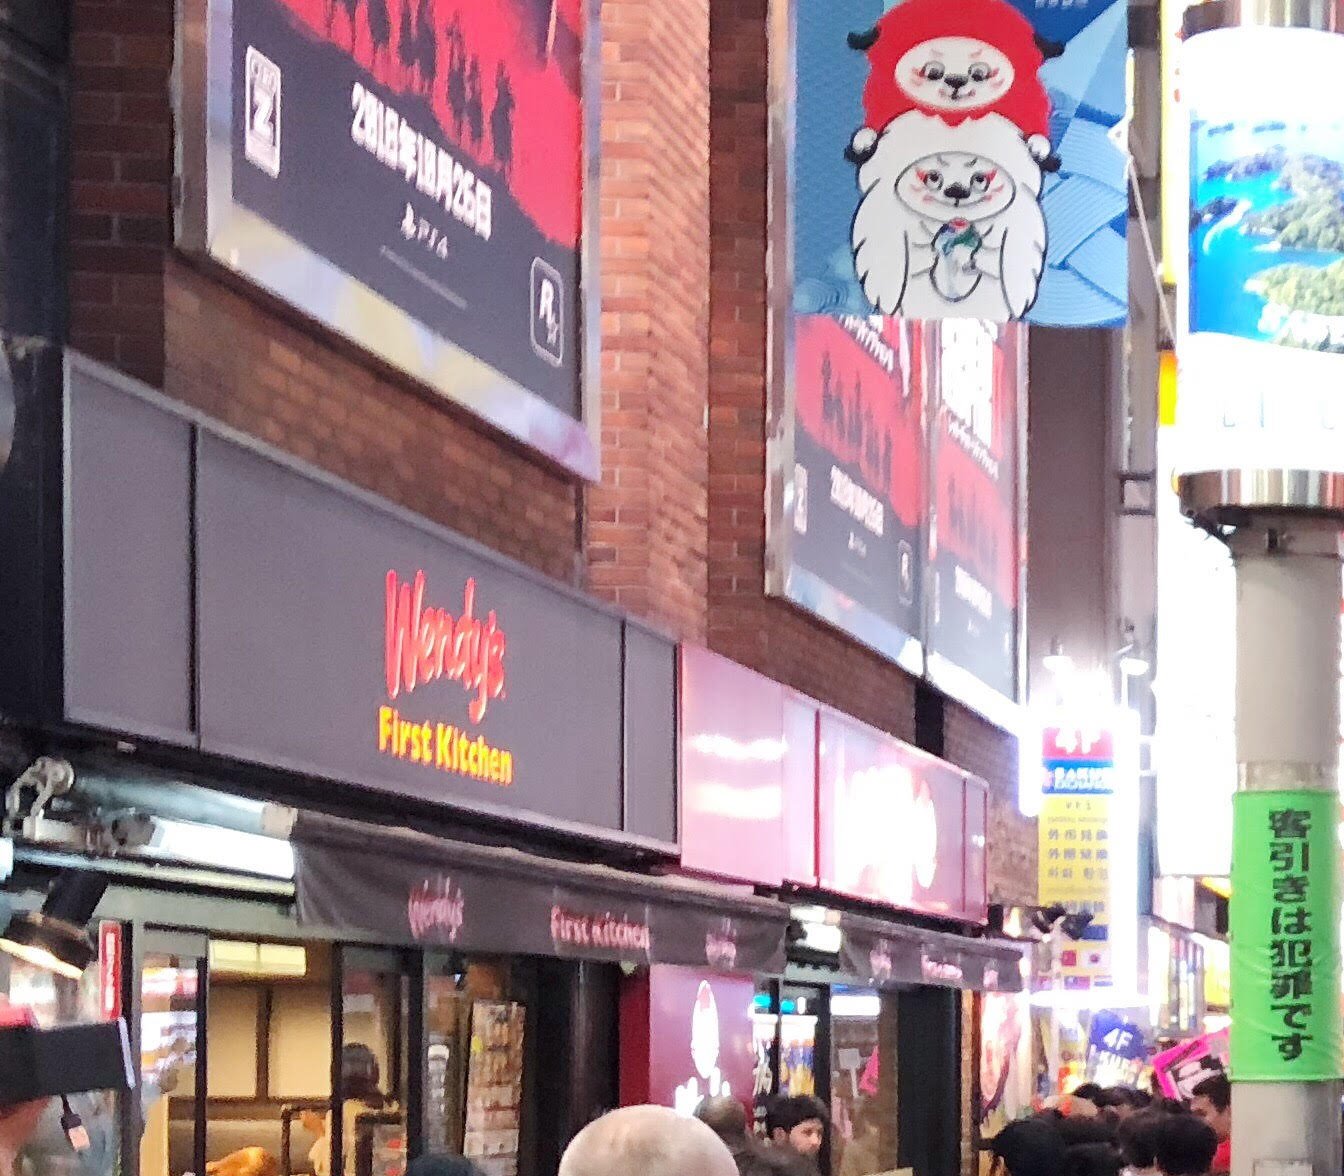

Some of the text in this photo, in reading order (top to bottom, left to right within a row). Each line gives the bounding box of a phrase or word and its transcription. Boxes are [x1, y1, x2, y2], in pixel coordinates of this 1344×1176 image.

[385, 568, 507, 725] Wendy's
[378, 704, 514, 785] First Kitchen
[1268, 807, 1314, 1063] 客引きは犯罪です
[1103, 1027, 1134, 1051] 4F
